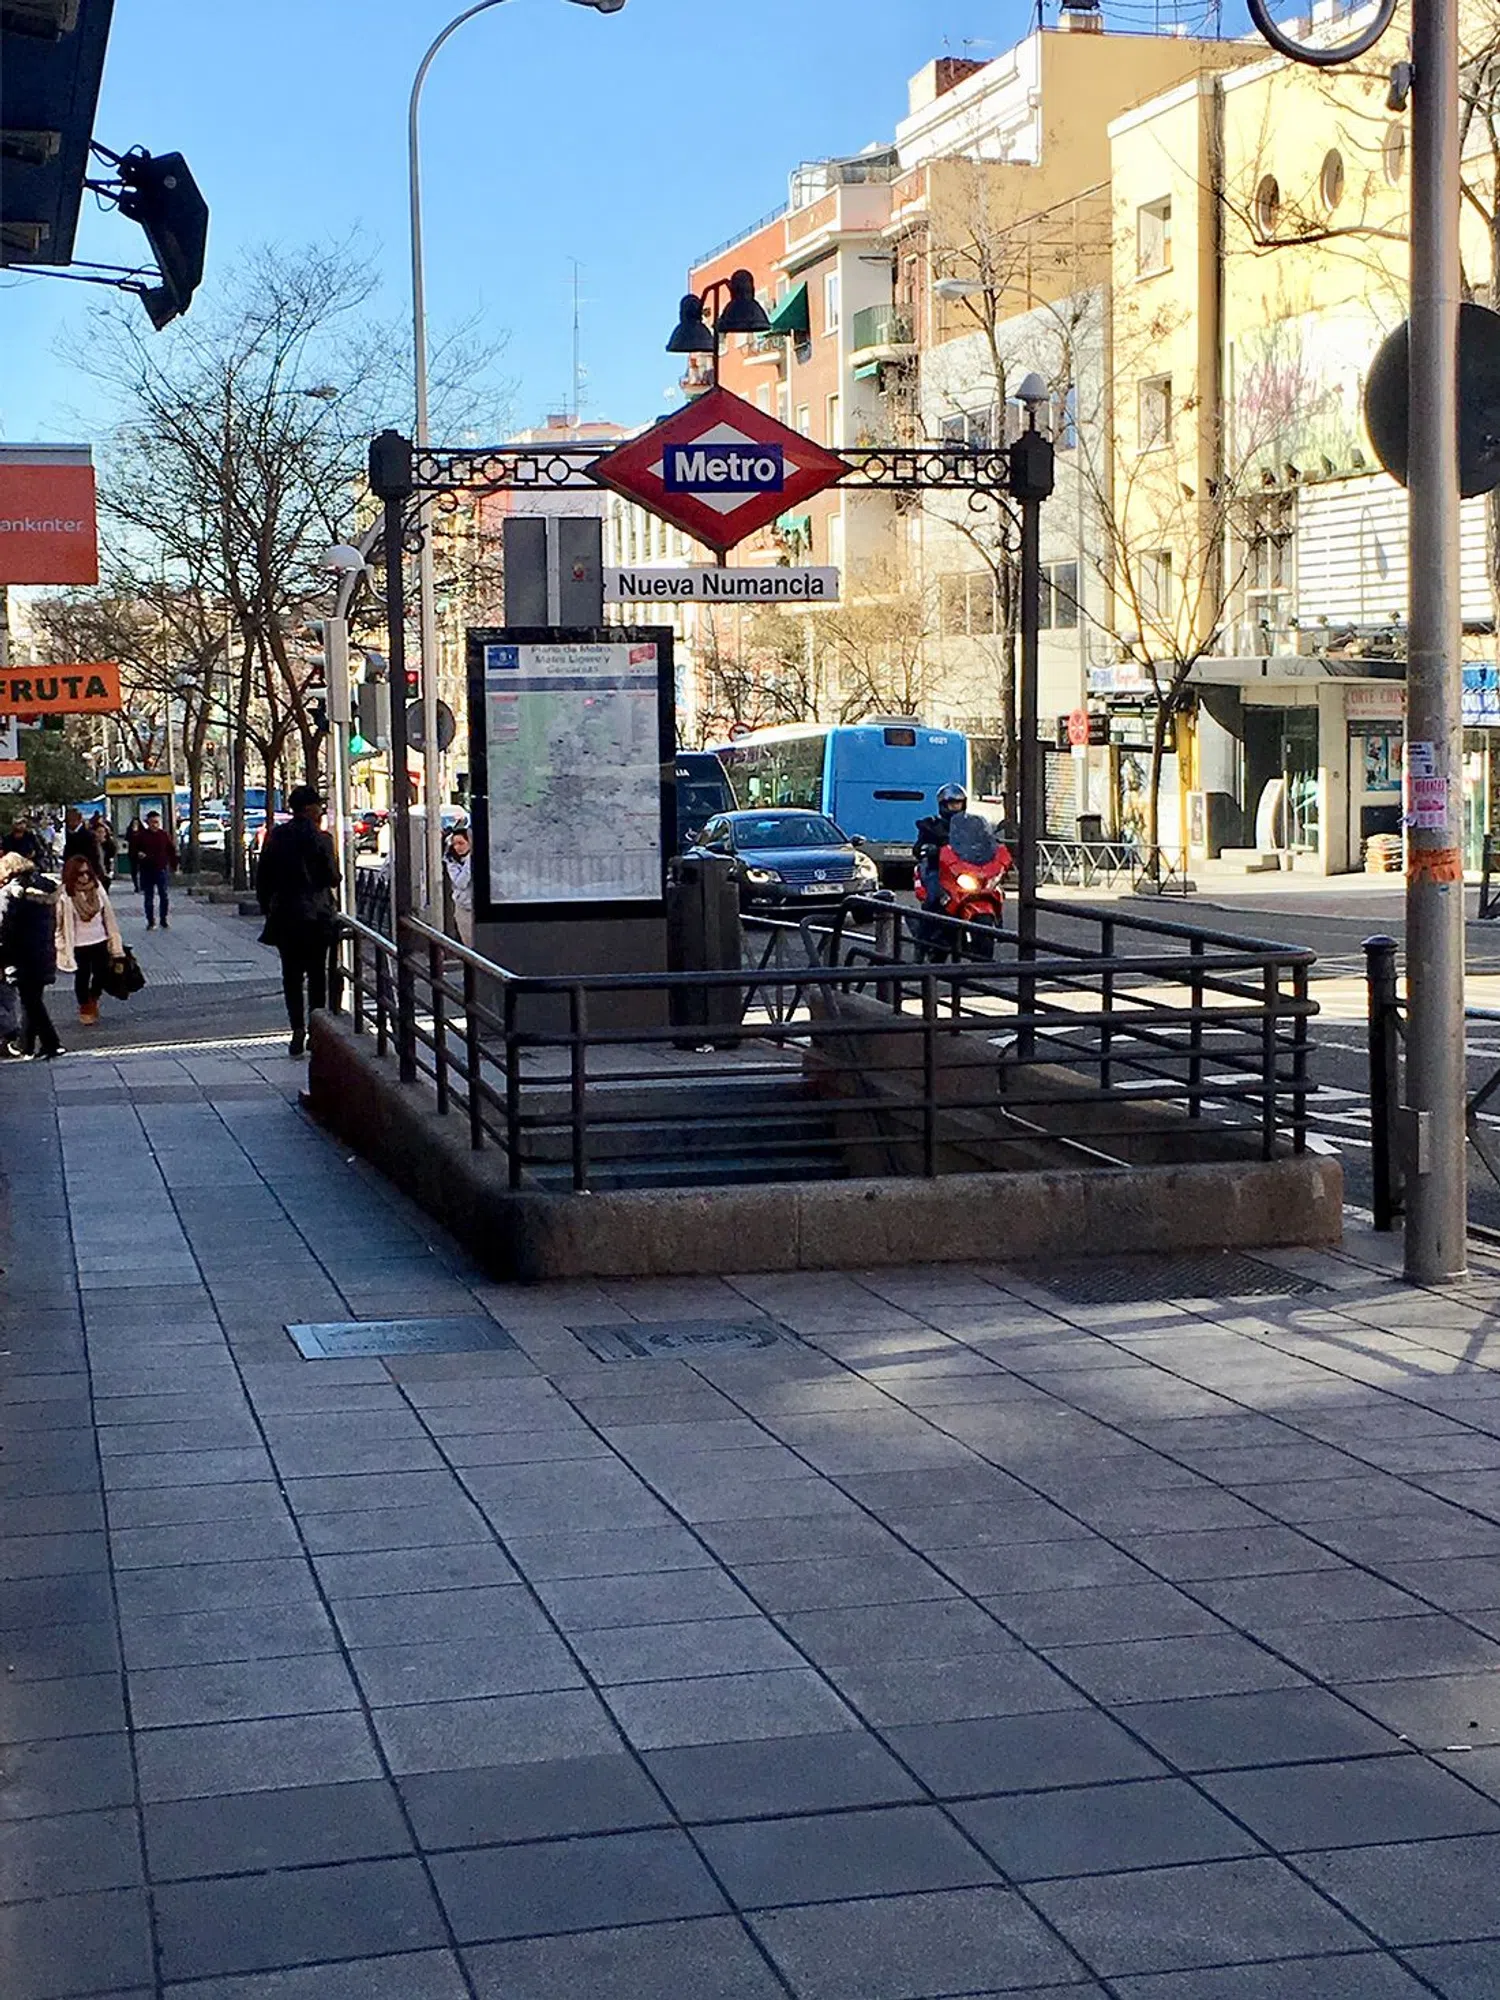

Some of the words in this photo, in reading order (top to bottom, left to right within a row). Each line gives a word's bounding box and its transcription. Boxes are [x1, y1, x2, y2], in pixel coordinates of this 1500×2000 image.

[674, 451, 776, 482] Metro
[619, 573, 694, 595] Nueva
[702, 573, 824, 596] Numancia
